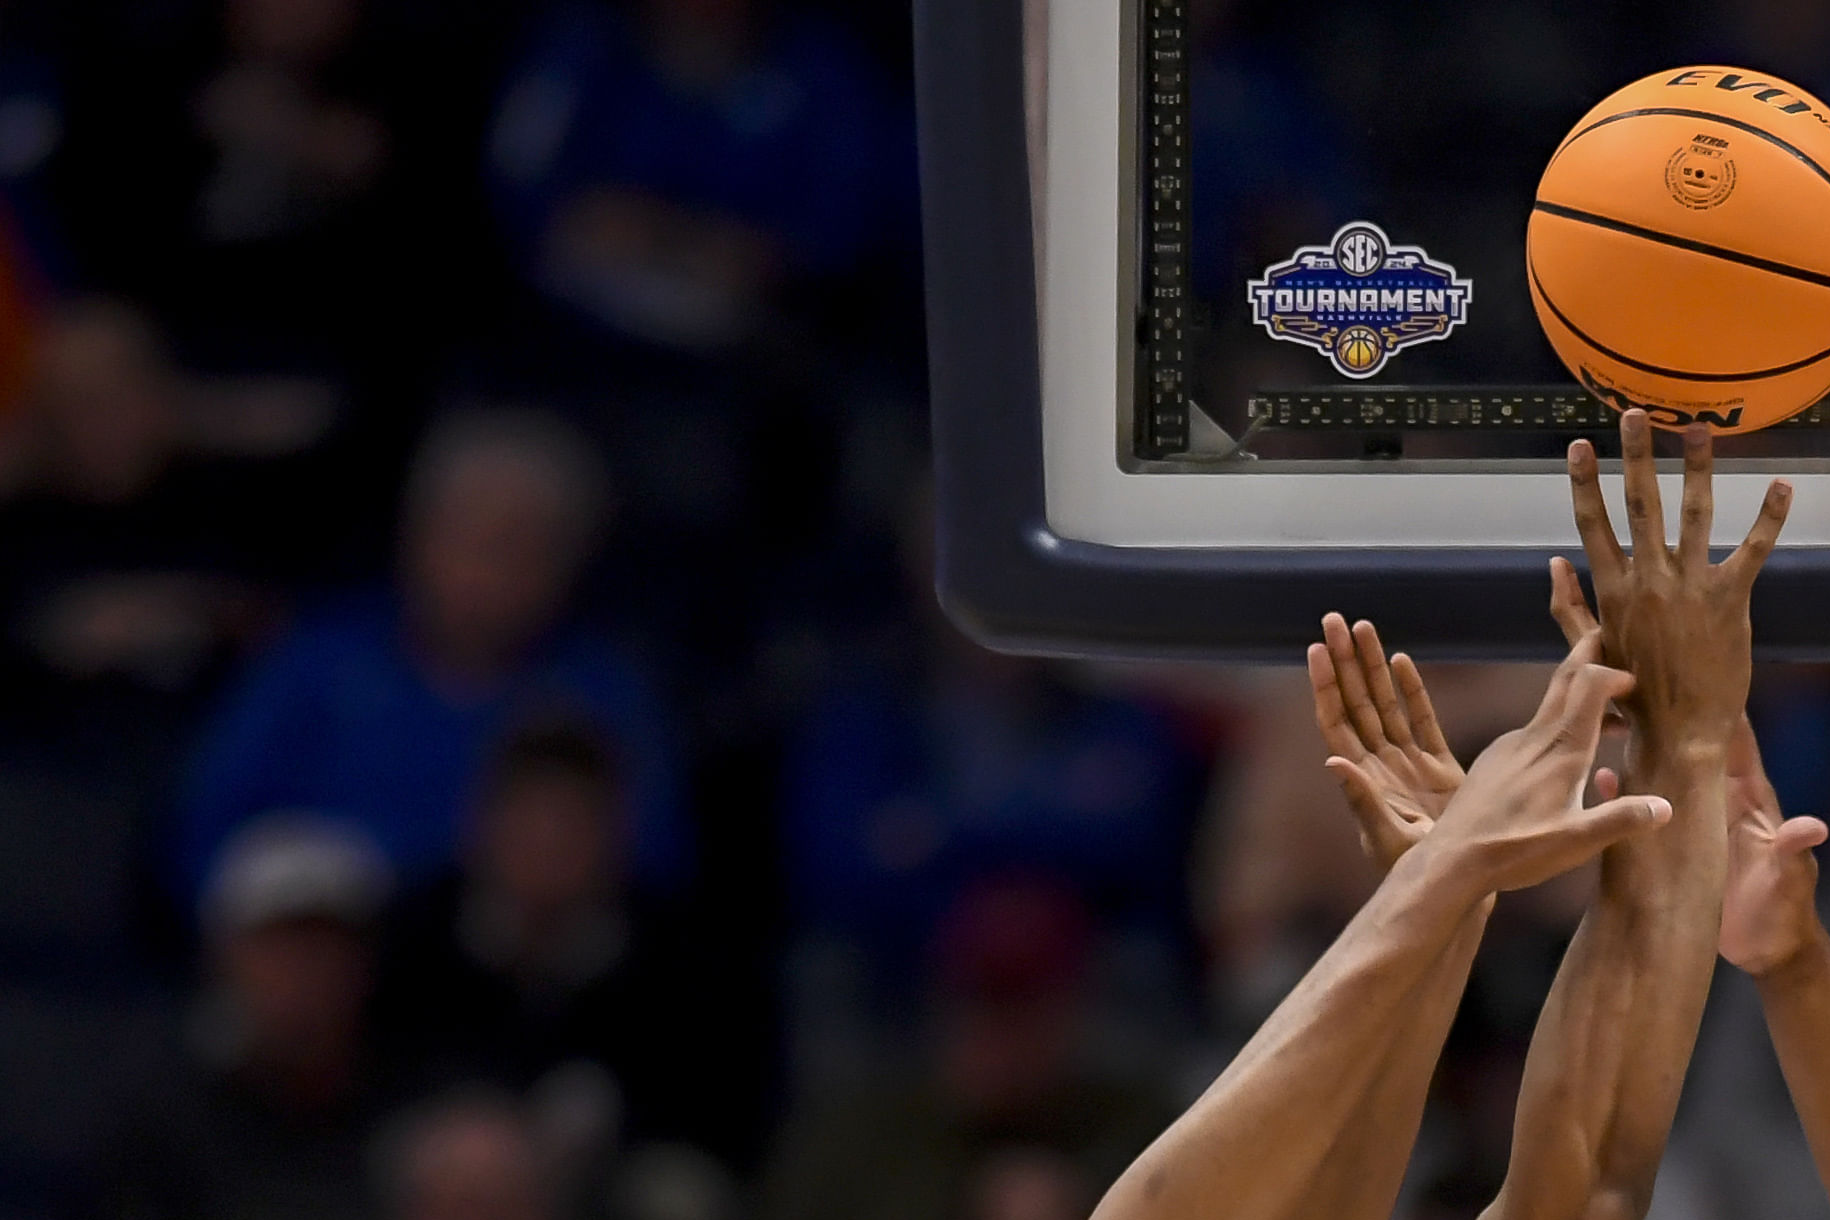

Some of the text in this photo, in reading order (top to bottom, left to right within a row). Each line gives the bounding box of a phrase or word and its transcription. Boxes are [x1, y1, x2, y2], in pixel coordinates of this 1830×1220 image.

[1666, 71, 1811, 114] EVO
[1341, 234, 1379, 273] SEC
[1256, 289, 1463, 316] TOURNAMENT
